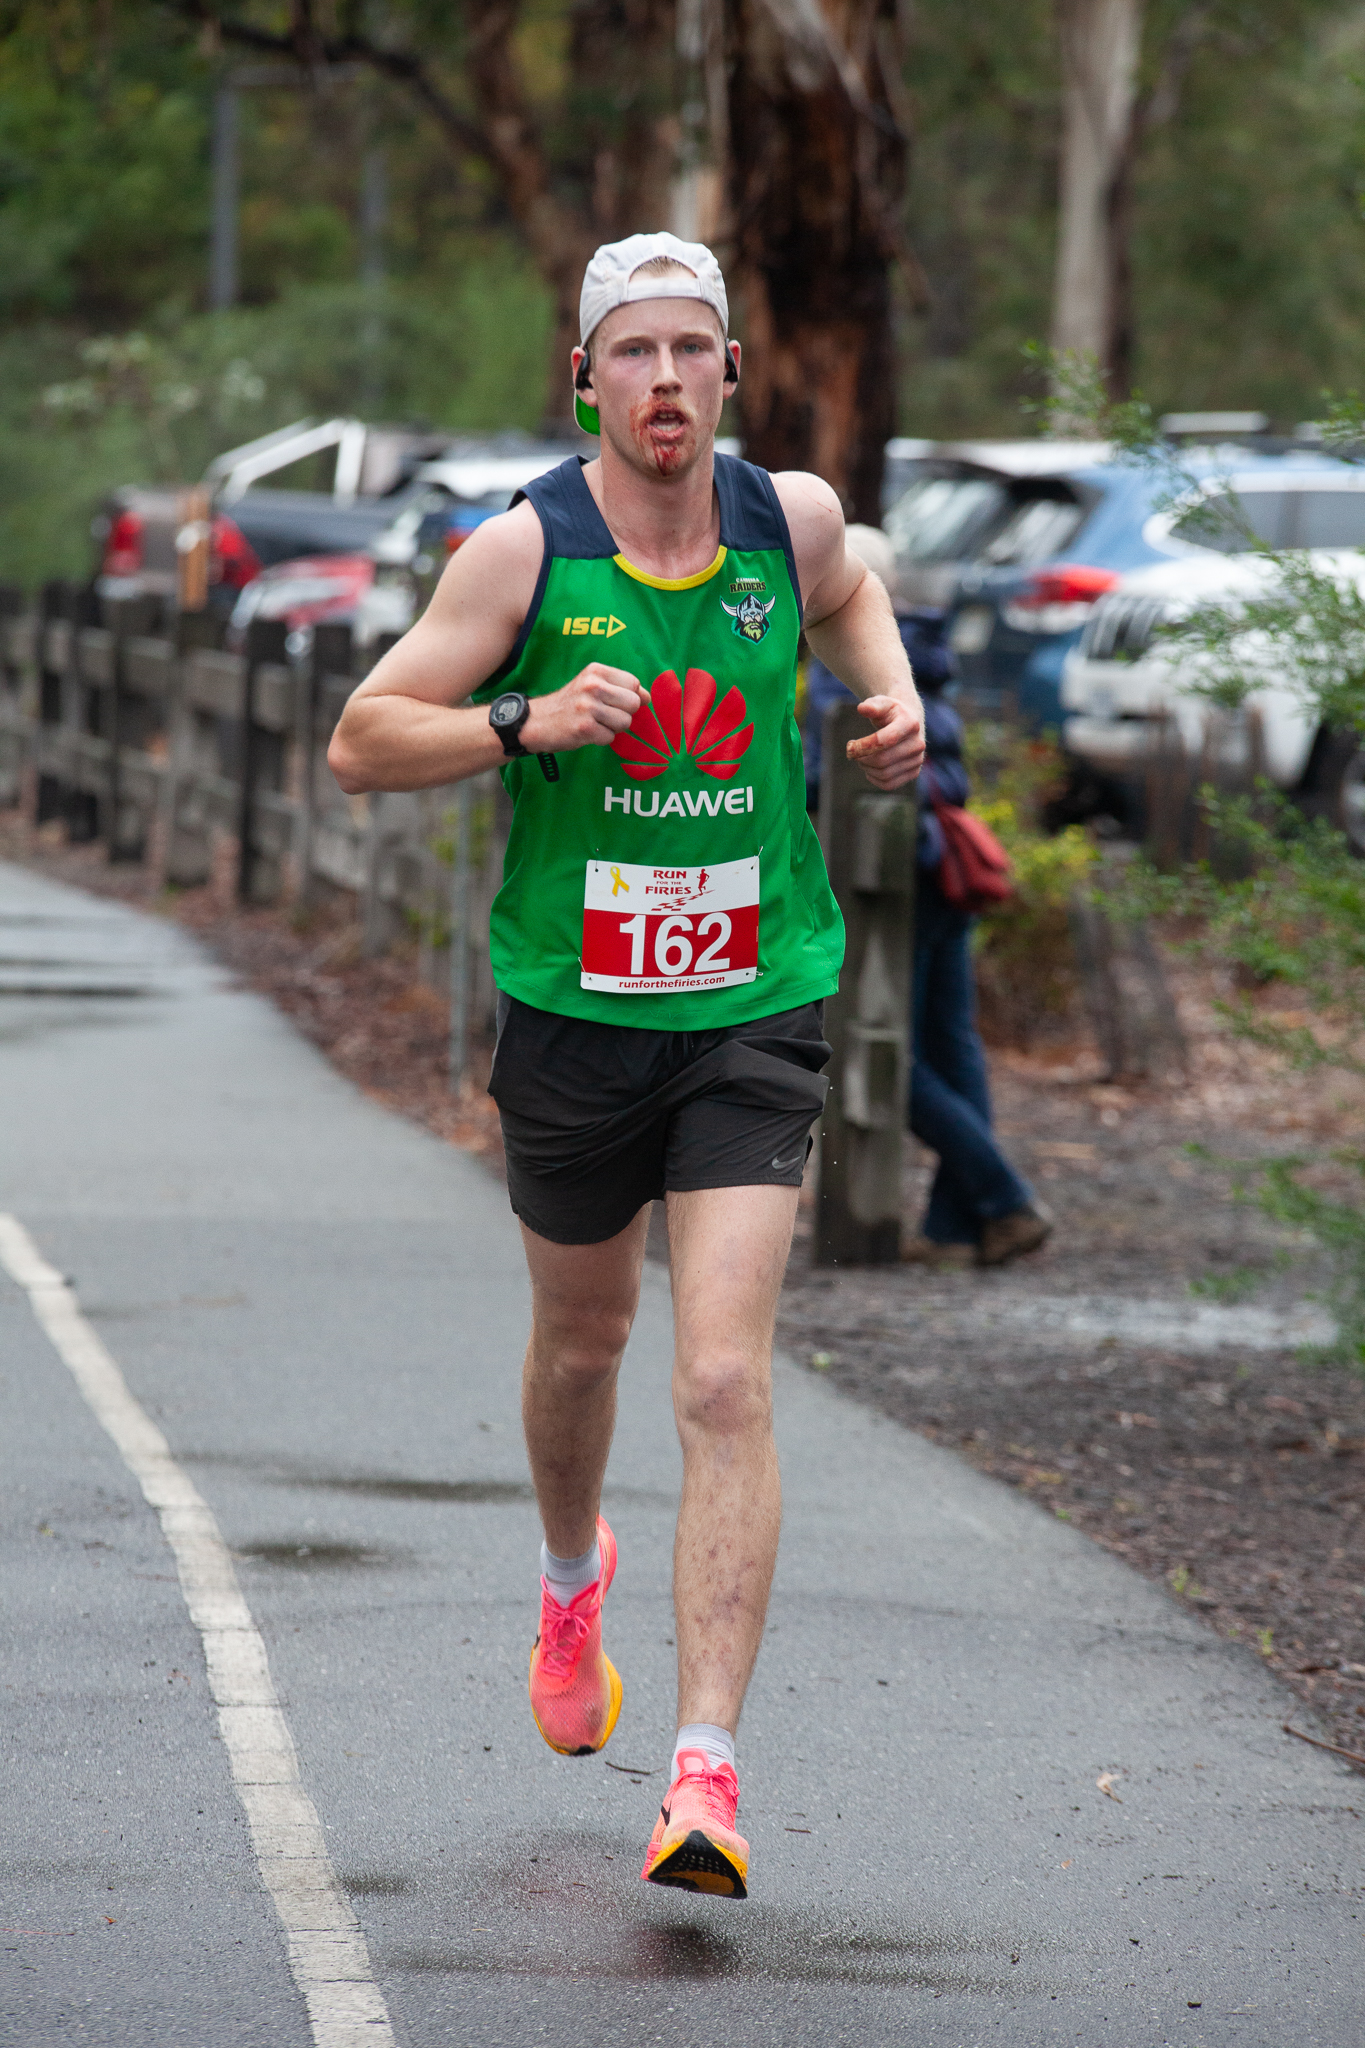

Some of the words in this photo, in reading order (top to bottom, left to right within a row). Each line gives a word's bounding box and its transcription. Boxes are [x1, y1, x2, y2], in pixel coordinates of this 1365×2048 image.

[730, 581, 767, 593] RAIDERS
[562, 617, 607, 635] ISC
[604, 786, 754, 817] HUAWEI
[653, 869, 687, 879] RUN
[645, 885, 692, 895] FIRIES
[620, 912, 732, 976] 162
[619, 976, 725, 988] runforthefiries.com
